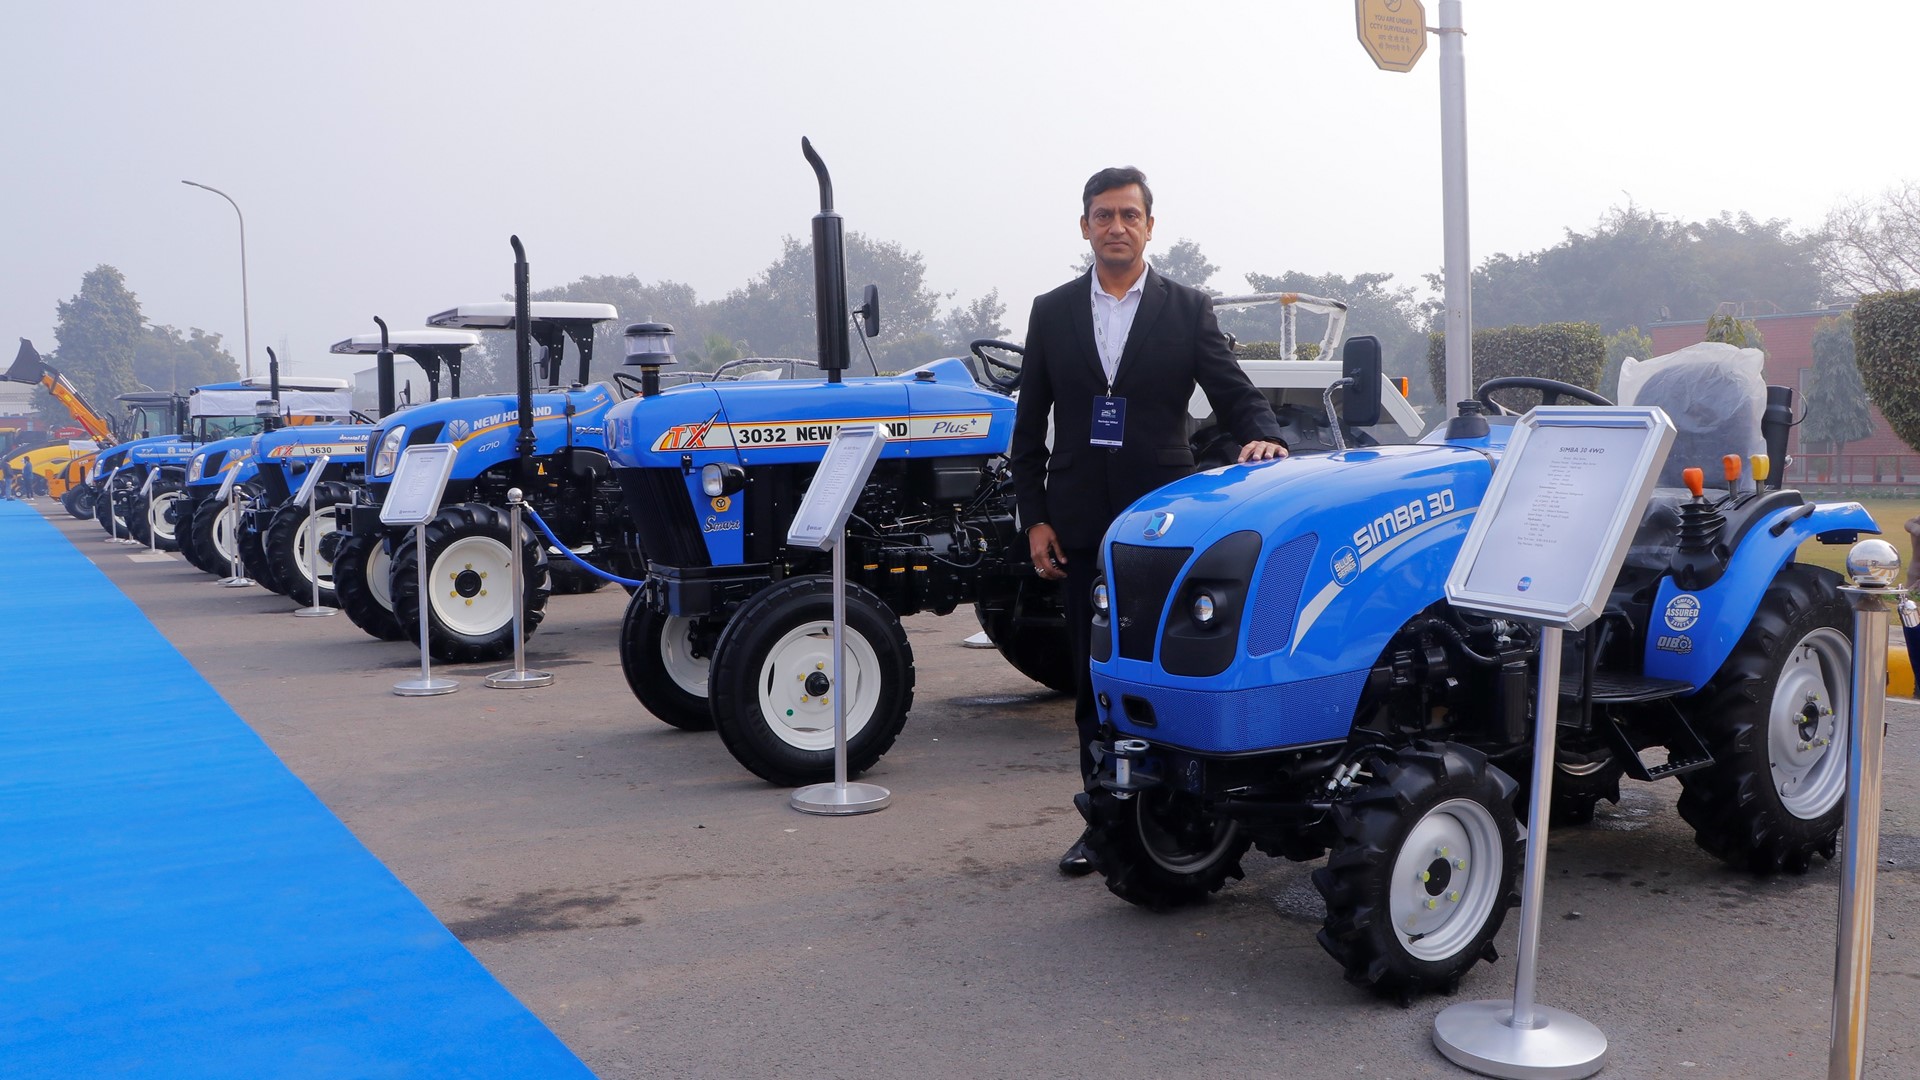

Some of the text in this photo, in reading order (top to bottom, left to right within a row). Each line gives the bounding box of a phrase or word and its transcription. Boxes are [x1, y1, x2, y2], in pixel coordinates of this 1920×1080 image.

[473, 414, 500, 430] NEW
[669, 417, 832, 449] TX 3032 NEW
[704, 515, 740, 532] Smart
[1354, 489, 1454, 554] SIMBA 30
[1334, 553, 1354, 573] BLUE
[1673, 598, 1696, 607] COMFORT
[1666, 608, 1699, 617] ASSURED
[1671, 619, 1692, 628] SAFETY
